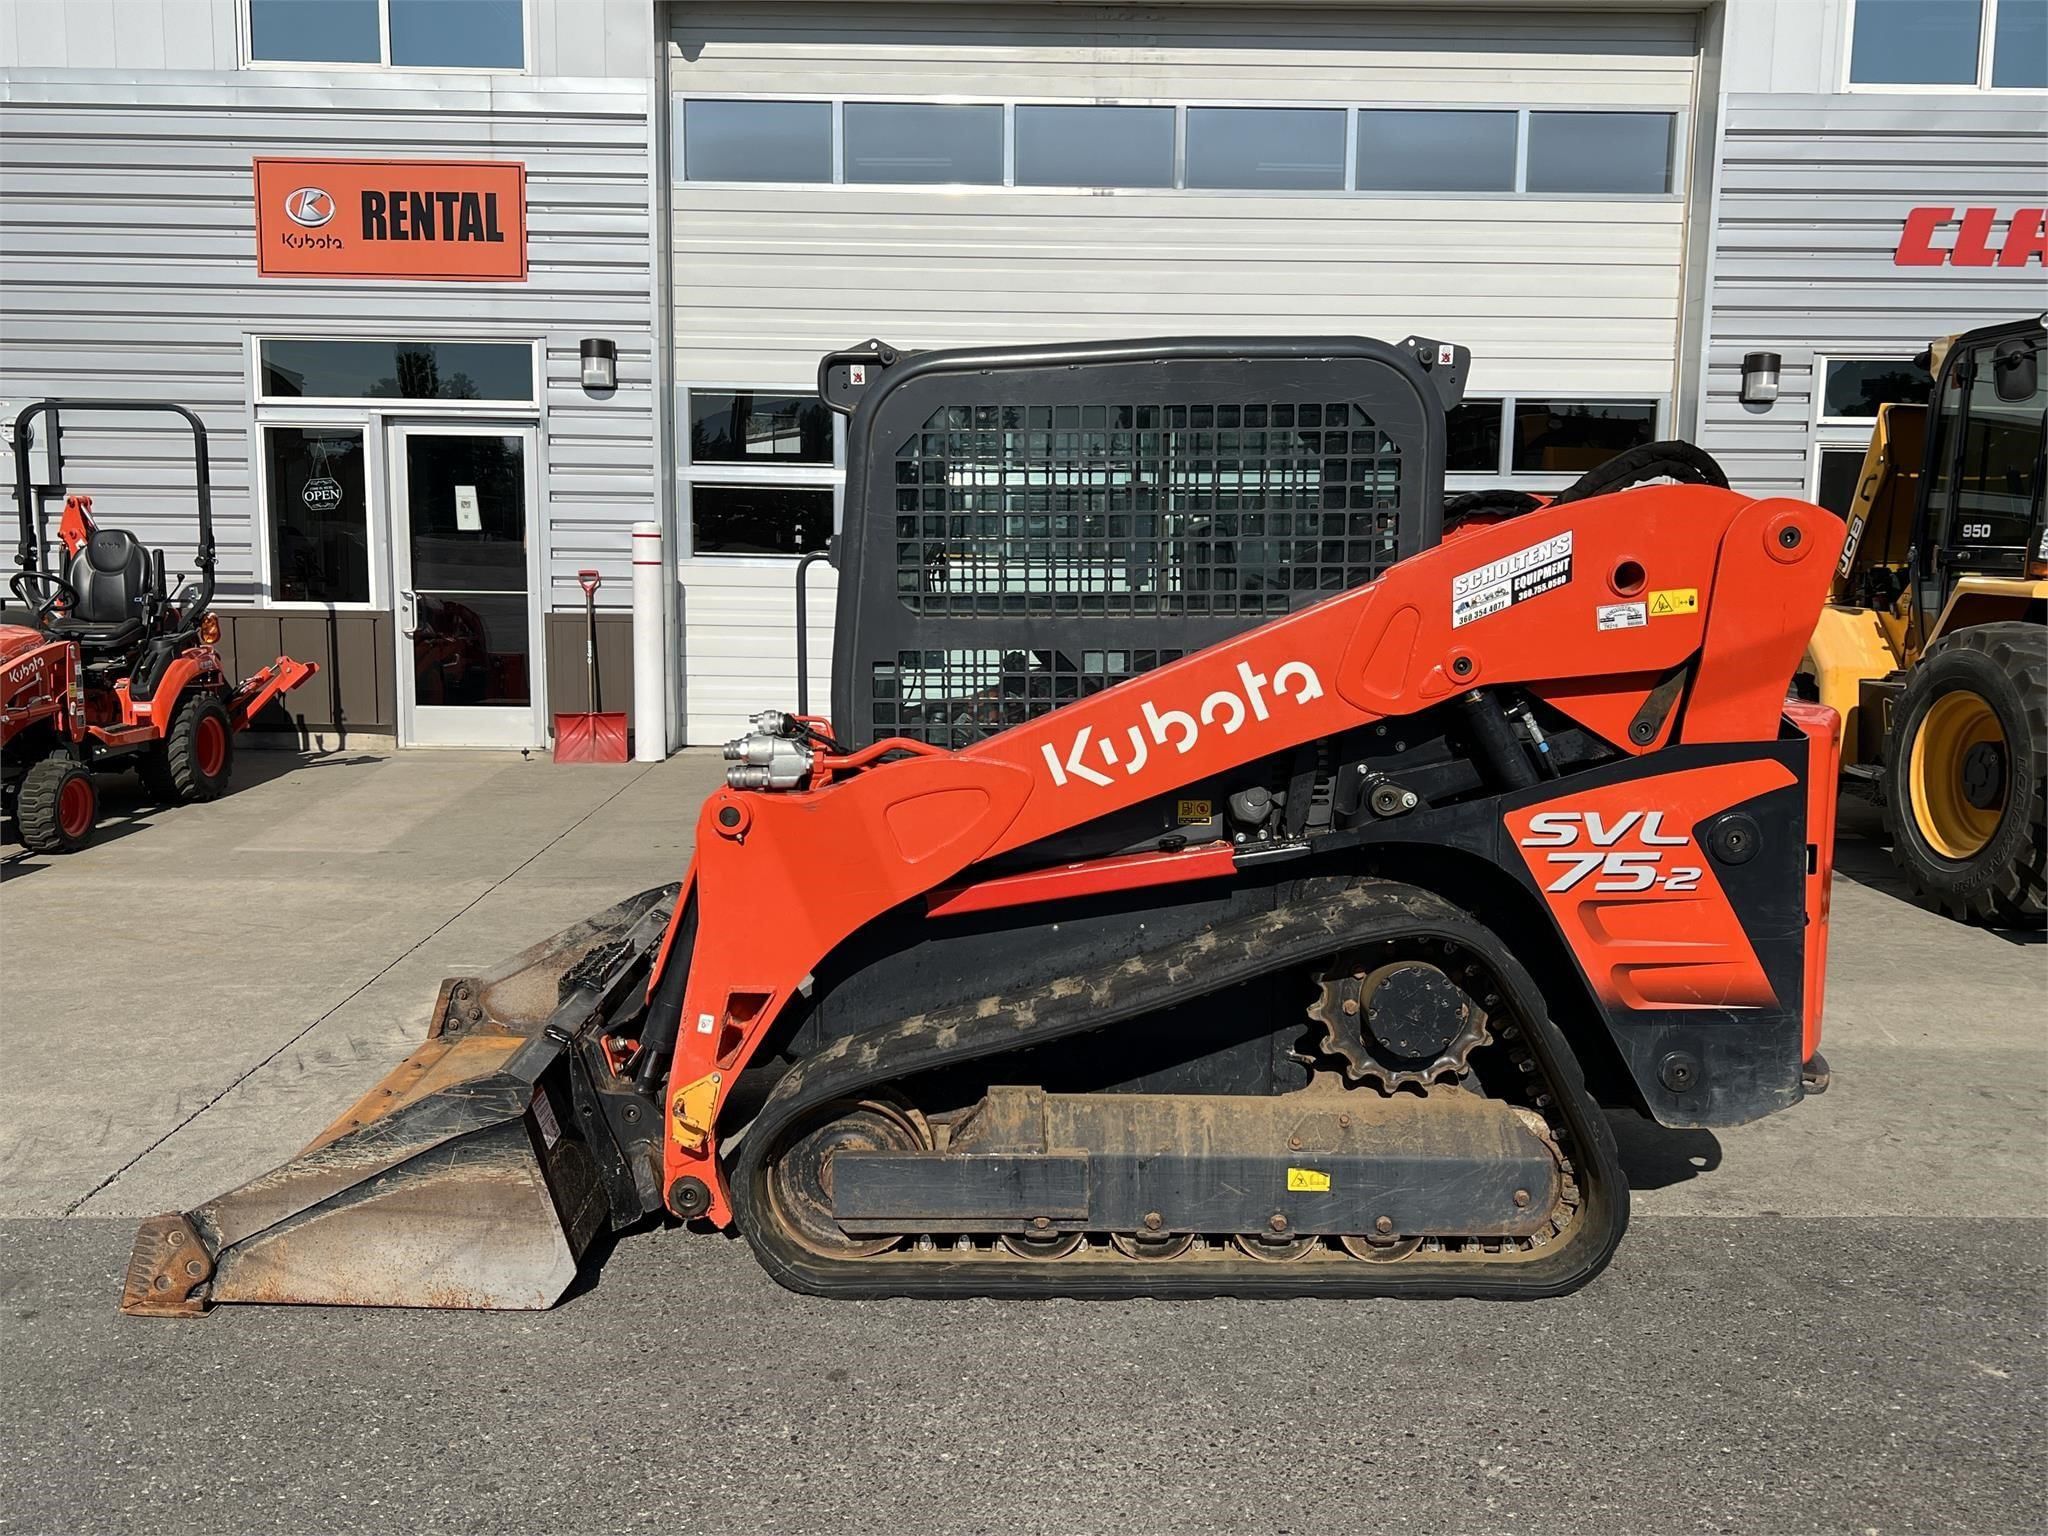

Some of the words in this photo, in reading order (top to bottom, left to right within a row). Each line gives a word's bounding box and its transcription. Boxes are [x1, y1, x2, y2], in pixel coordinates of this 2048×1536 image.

[361, 190, 504, 242] RENTAL
[282, 232, 342, 249] Kubota
[304, 489, 340, 501] OPEN
[1840, 516, 1863, 573] JCB
[1963, 524, 1991, 538] 950
[1455, 535, 1570, 596] SCHOLTEN'S
[1514, 557, 1570, 591] EQUIPMENT
[1459, 613, 1473, 625] 360
[1474, 607, 1487, 619] 354
[1489, 600, 1505, 613] 4071
[9, 656, 45, 682] Kubota
[1041, 661, 1324, 787] Kubota
[1520, 811, 1690, 846] SVL
[1545, 852, 1703, 892] 75-2
